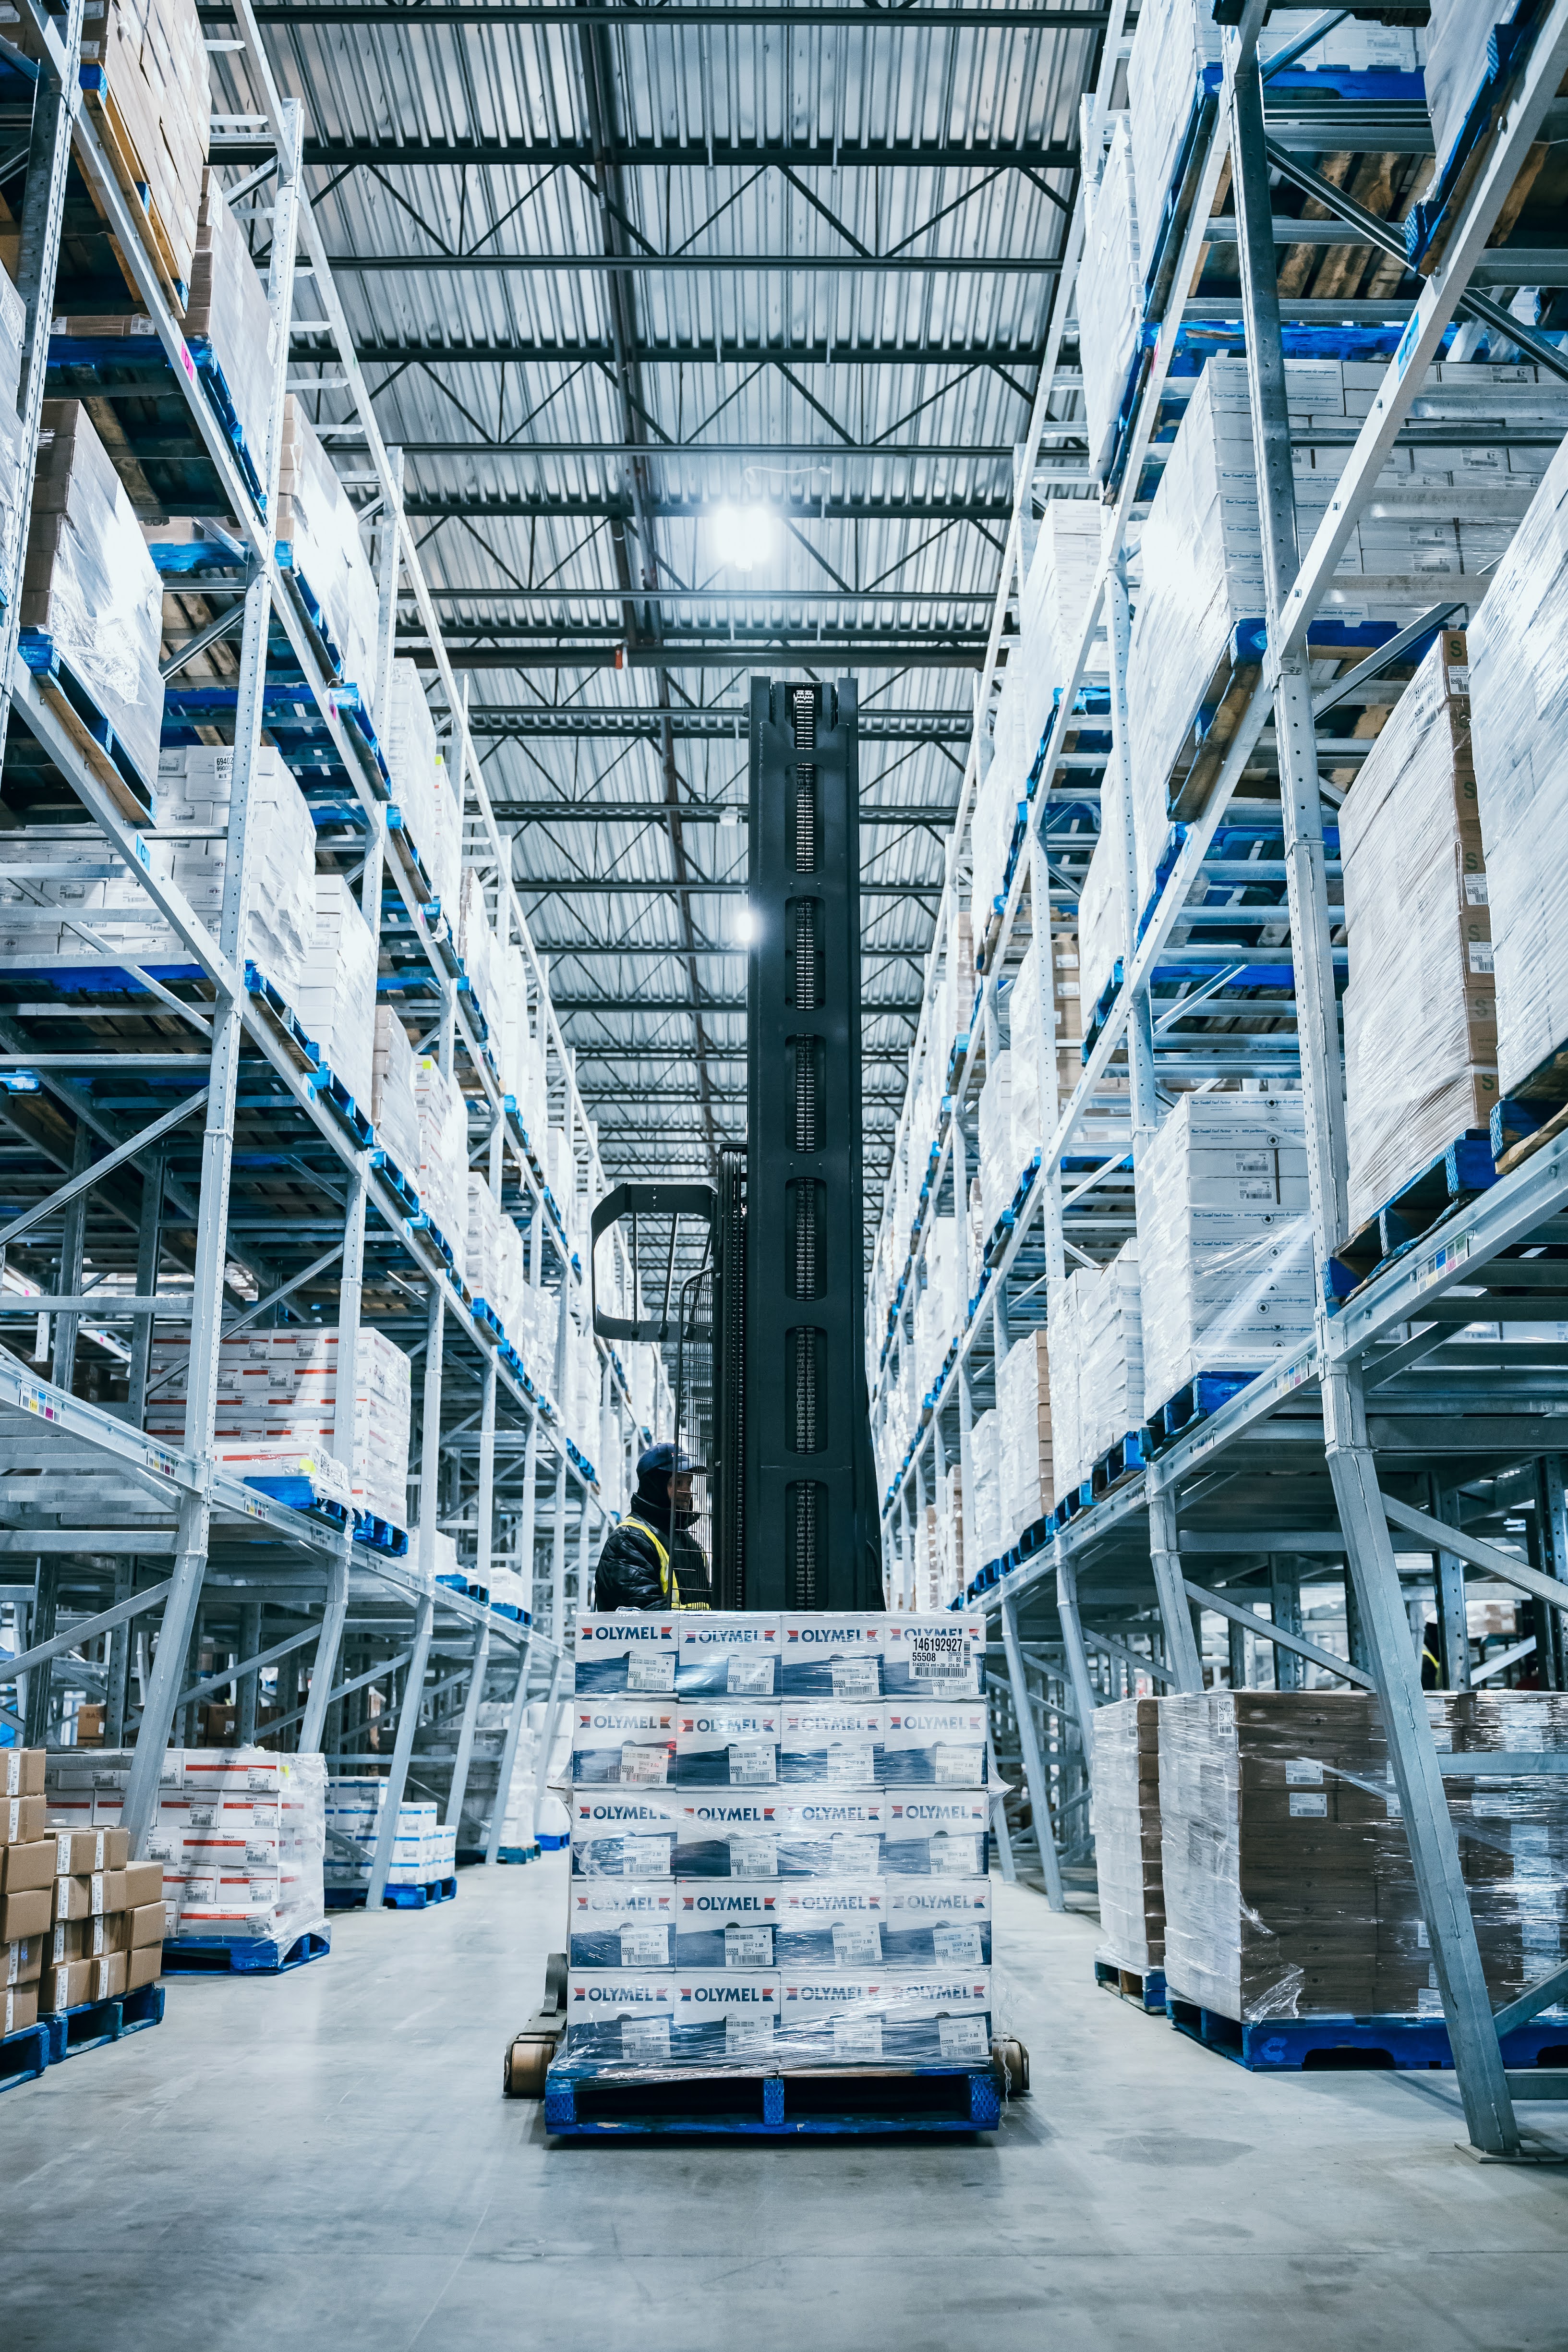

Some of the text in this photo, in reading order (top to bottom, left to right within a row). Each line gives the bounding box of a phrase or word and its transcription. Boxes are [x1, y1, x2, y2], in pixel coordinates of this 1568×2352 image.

[1450, 640, 1462, 657] S
[1464, 781, 1476, 800] S
[141, 844, 145, 862] C
[1466, 852, 1478, 870] S
[1468, 924, 1480, 942] S
[1482, 1074, 1494, 1091] S
[596, 1627, 658, 1640] OLYMEL
[699, 1630, 761, 1643] OLYMEL
[802, 1630, 865, 1642] OLYMEL
[913, 1637, 963, 1651] 146192927
[912, 1652, 936, 1661] 55508
[594, 1715, 657, 1728] OLYMEL
[904, 1716, 966, 1729] OLYMEL
[593, 1806, 657, 1819] OLYMEL
[697, 1807, 760, 1820] OLYMEL
[802, 1807, 865, 1820] OLYMEL
[906, 1806, 969, 1819] OLYMEL
[697, 1897, 761, 1910] OLYMEL
[802, 1896, 866, 1910] OLYMEL
[907, 1895, 971, 1909] OLYMEL
[936, 1949, 948, 1958] 55508
[589, 1988, 653, 2001] OLYMEL
[695, 1988, 759, 2001] OLYMEL
[801, 1987, 865, 2000] OLYMEL
